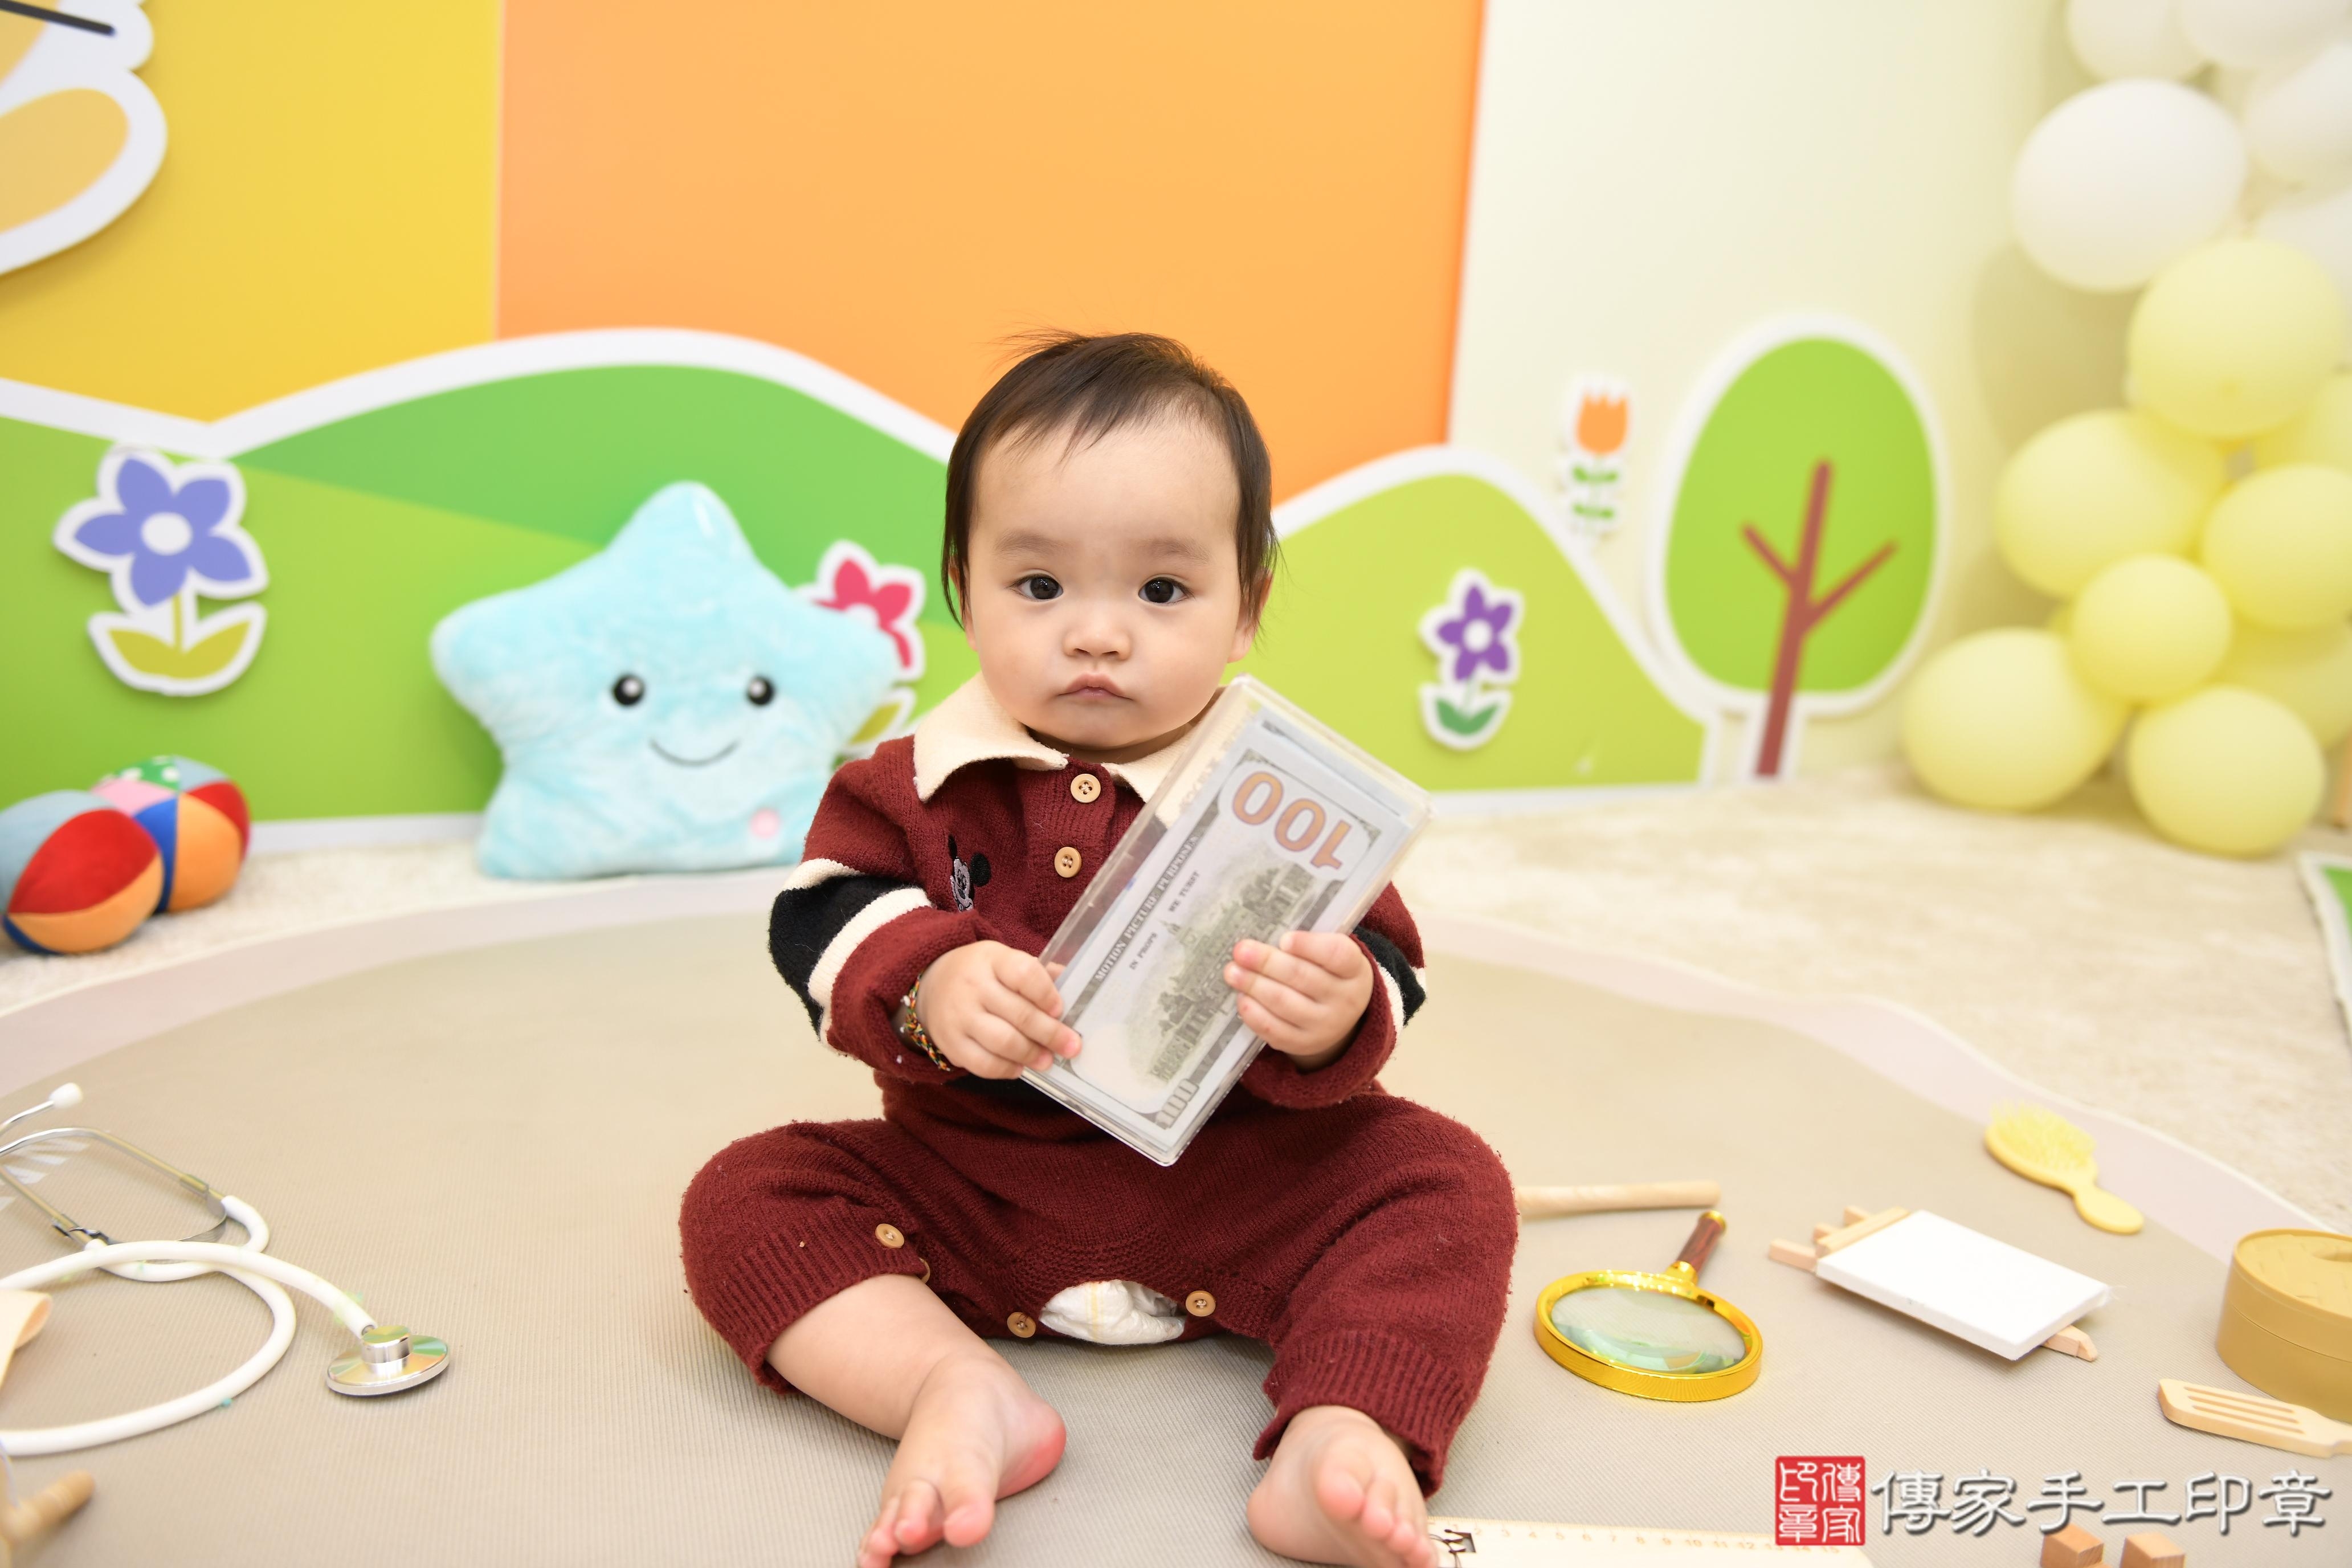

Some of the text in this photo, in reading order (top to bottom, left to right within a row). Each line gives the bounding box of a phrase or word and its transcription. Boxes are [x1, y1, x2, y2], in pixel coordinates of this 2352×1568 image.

[1232, 770, 1353, 871] 100
[1094, 833, 1200, 982] MOTION PICTURE PURPOSES
[1129, 959, 1140, 970] IN
[1136, 931, 1158, 959] PROPS
[1167, 899, 1181, 913] WE
